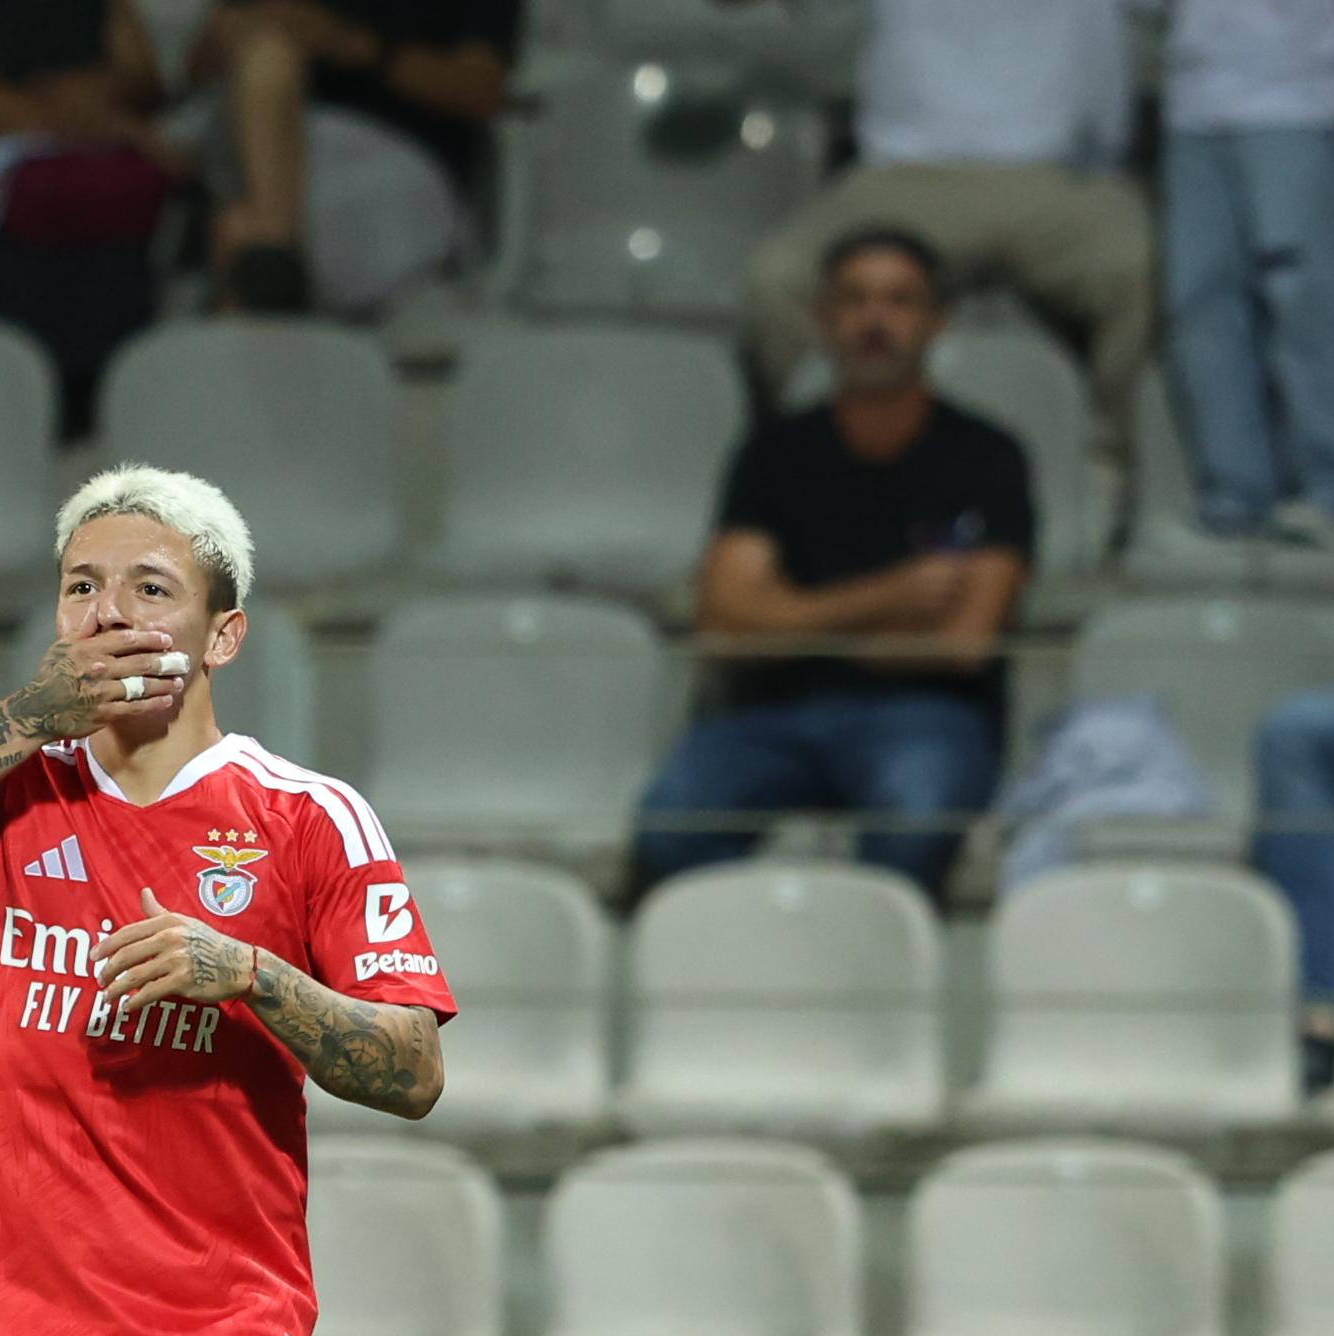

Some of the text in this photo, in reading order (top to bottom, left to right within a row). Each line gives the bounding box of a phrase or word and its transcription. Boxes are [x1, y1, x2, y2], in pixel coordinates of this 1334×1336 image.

[354, 948, 439, 982] Betano
[19, 981, 221, 1054] FLY BETTER
